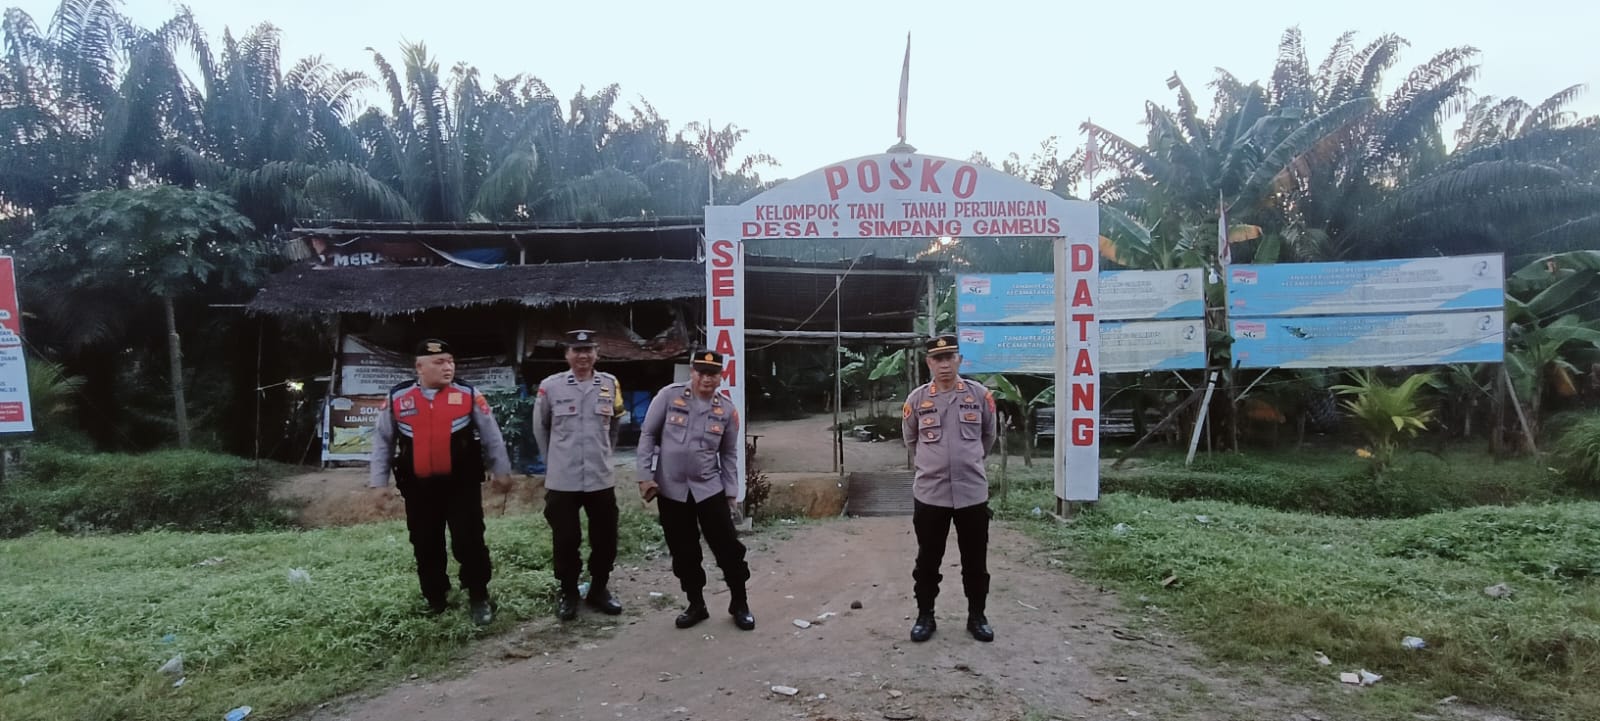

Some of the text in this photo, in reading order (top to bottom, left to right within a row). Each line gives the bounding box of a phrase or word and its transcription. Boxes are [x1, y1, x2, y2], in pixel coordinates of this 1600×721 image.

[825, 158, 978, 201] POSKO
[756, 200, 1047, 221] KELOMPOK TANI TANAH PERJUANGAN
[742, 221, 820, 238] DESA
[859, 219, 962, 236] SIMPANG
[972, 218, 1061, 235] GAMBUS
[711, 239, 737, 399] SELAM
[1071, 243, 1095, 446] DATANG
[360, 407, 379, 415] SOA
